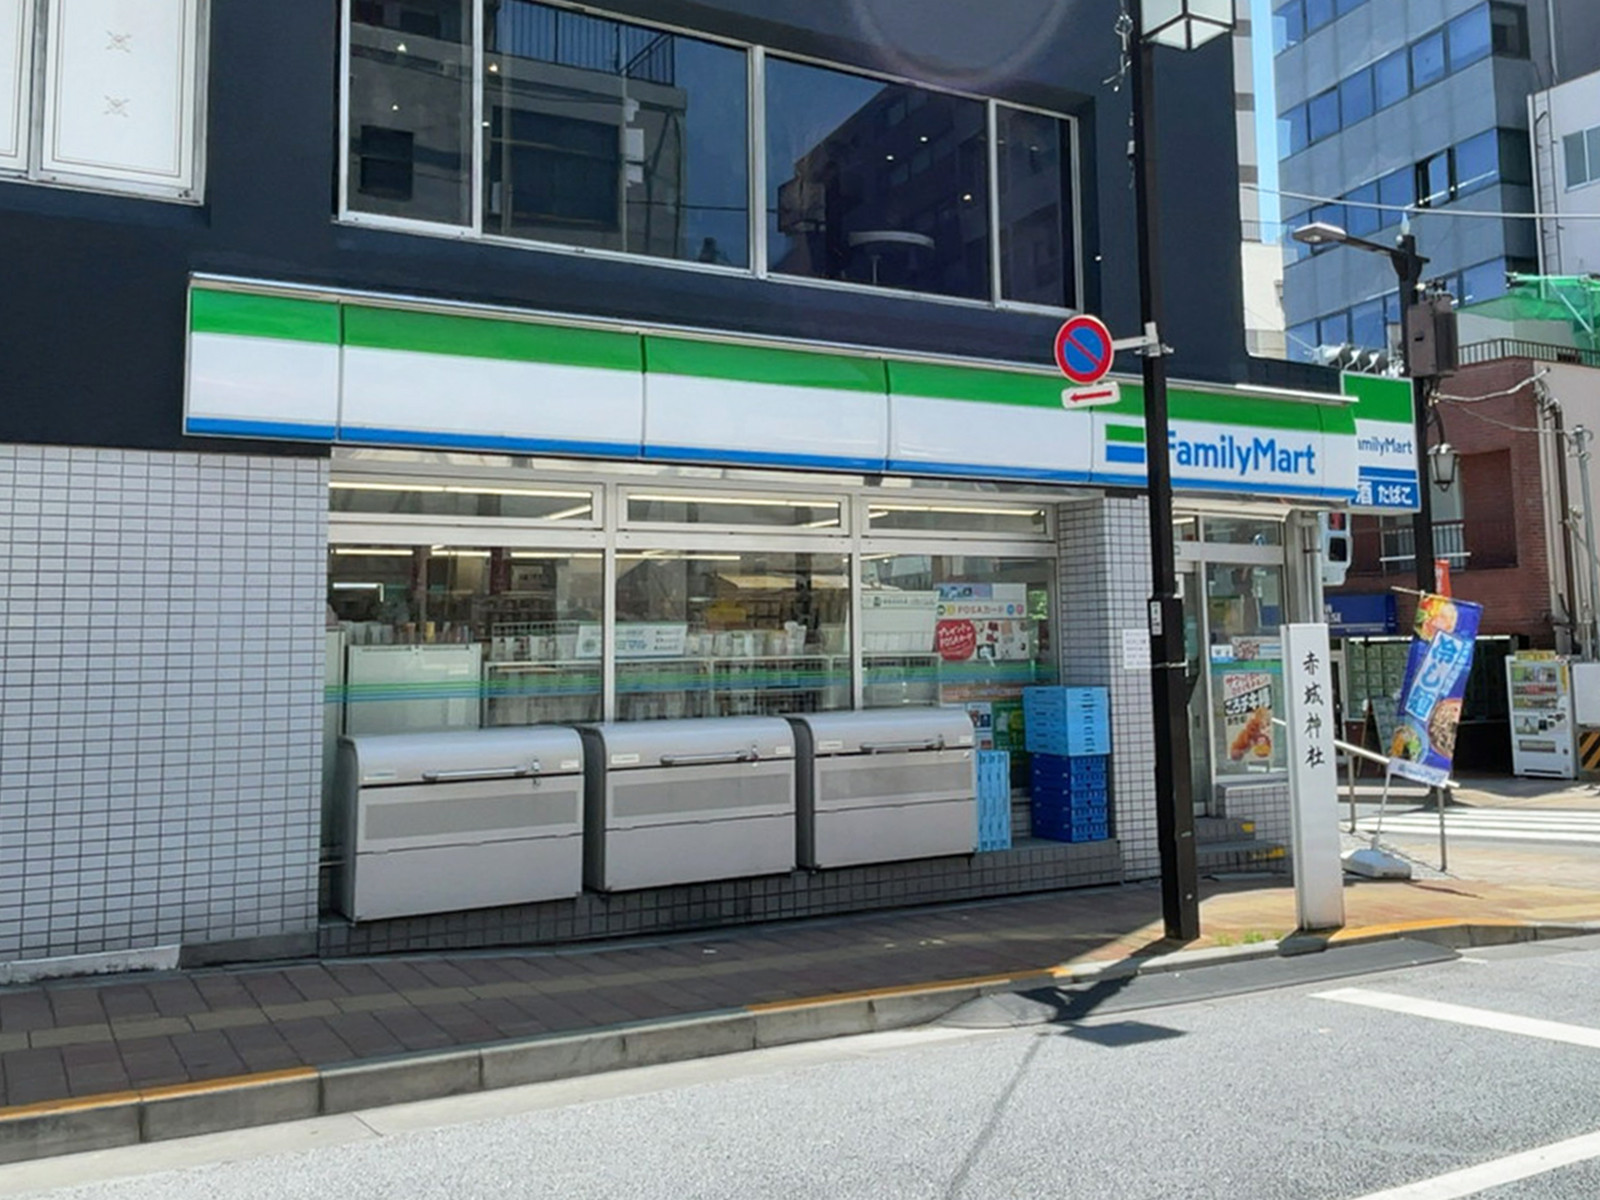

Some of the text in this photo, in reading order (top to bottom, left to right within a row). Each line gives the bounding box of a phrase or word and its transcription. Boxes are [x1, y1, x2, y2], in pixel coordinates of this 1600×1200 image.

[1378, 484, 1413, 505] たばこ
[1303, 651, 1325, 768] 赤城神社
